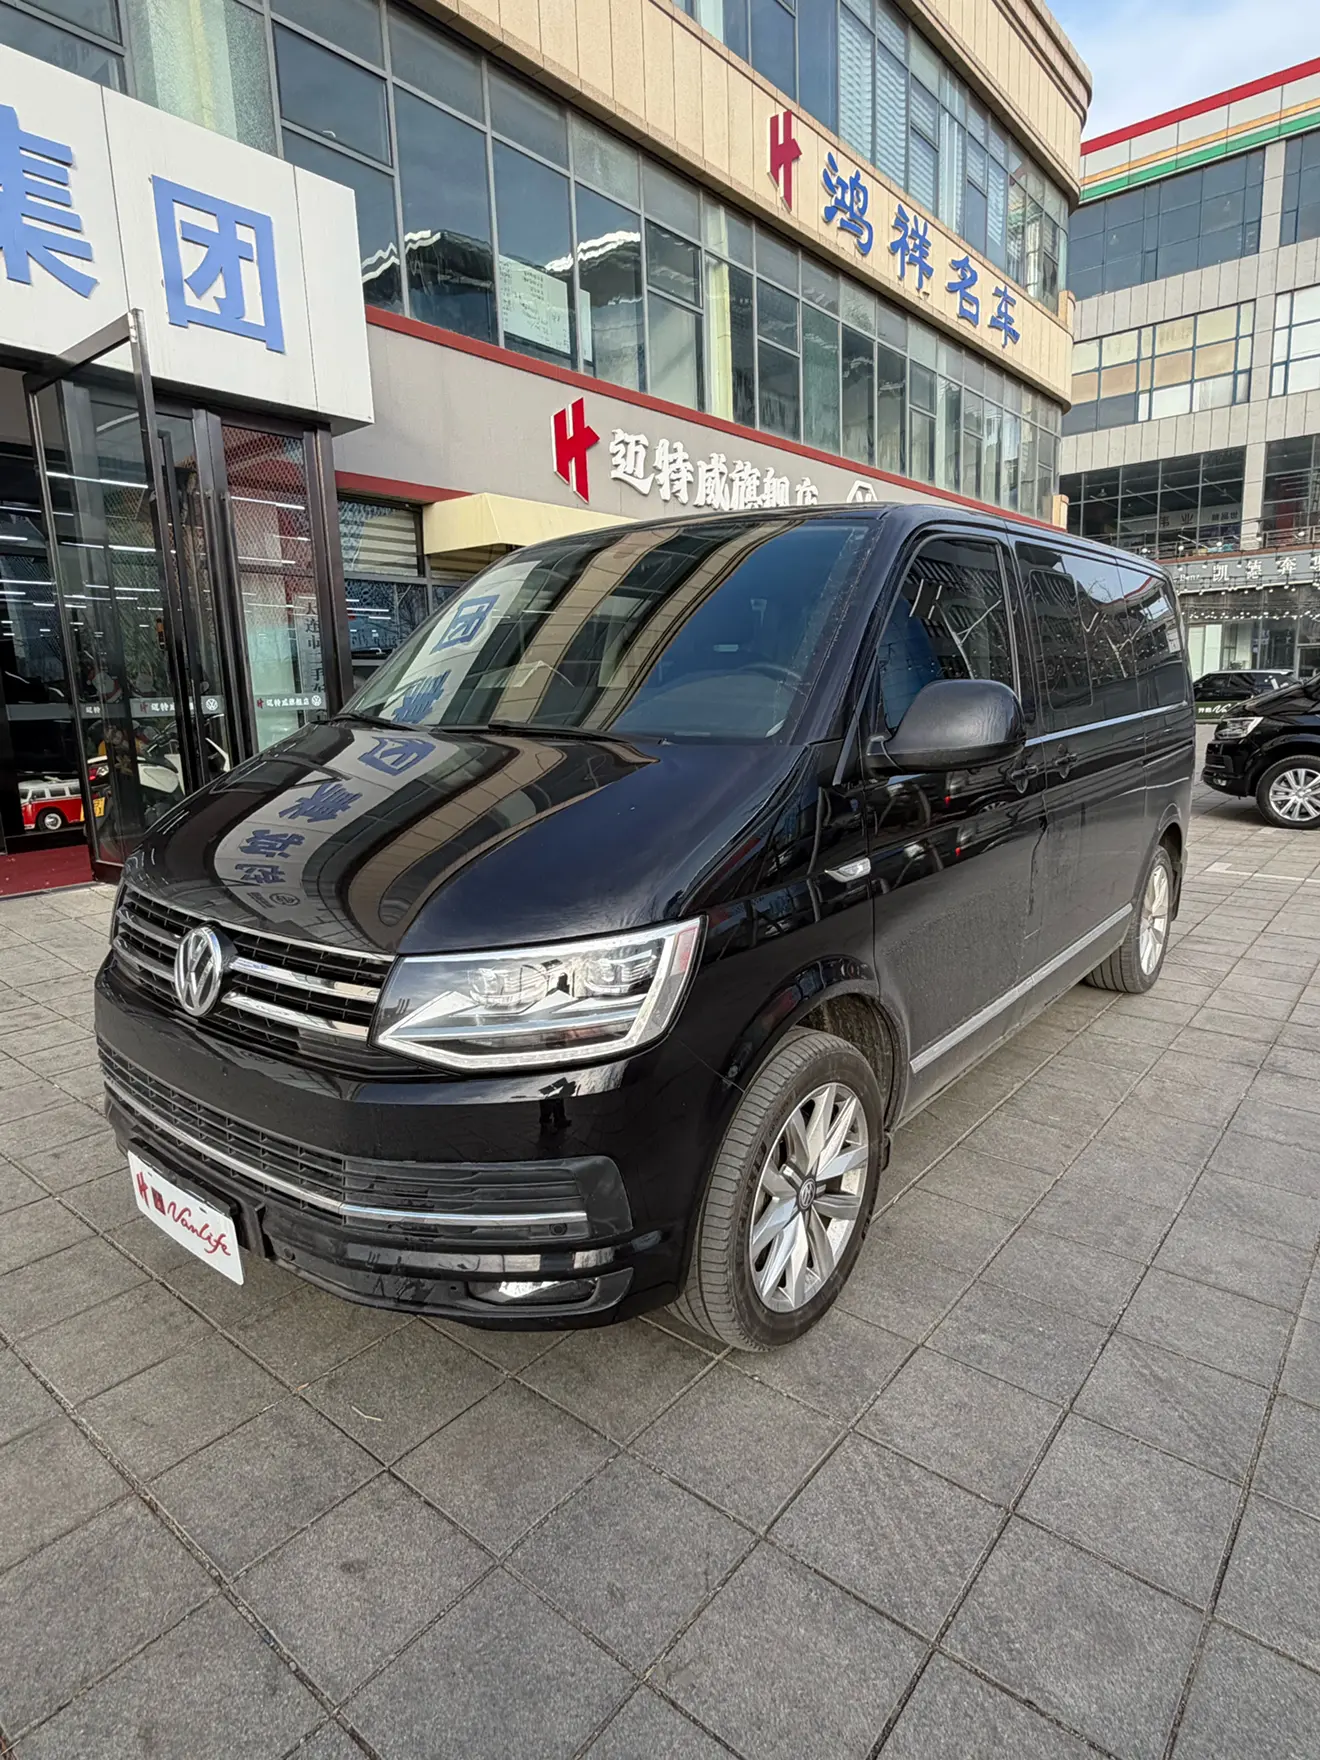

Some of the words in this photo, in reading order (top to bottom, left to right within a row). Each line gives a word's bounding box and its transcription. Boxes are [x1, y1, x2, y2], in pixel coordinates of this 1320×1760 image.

[821, 151, 1020, 349] 鸿祥名车
[609, 428, 819, 512] 迈特威旗舰店
